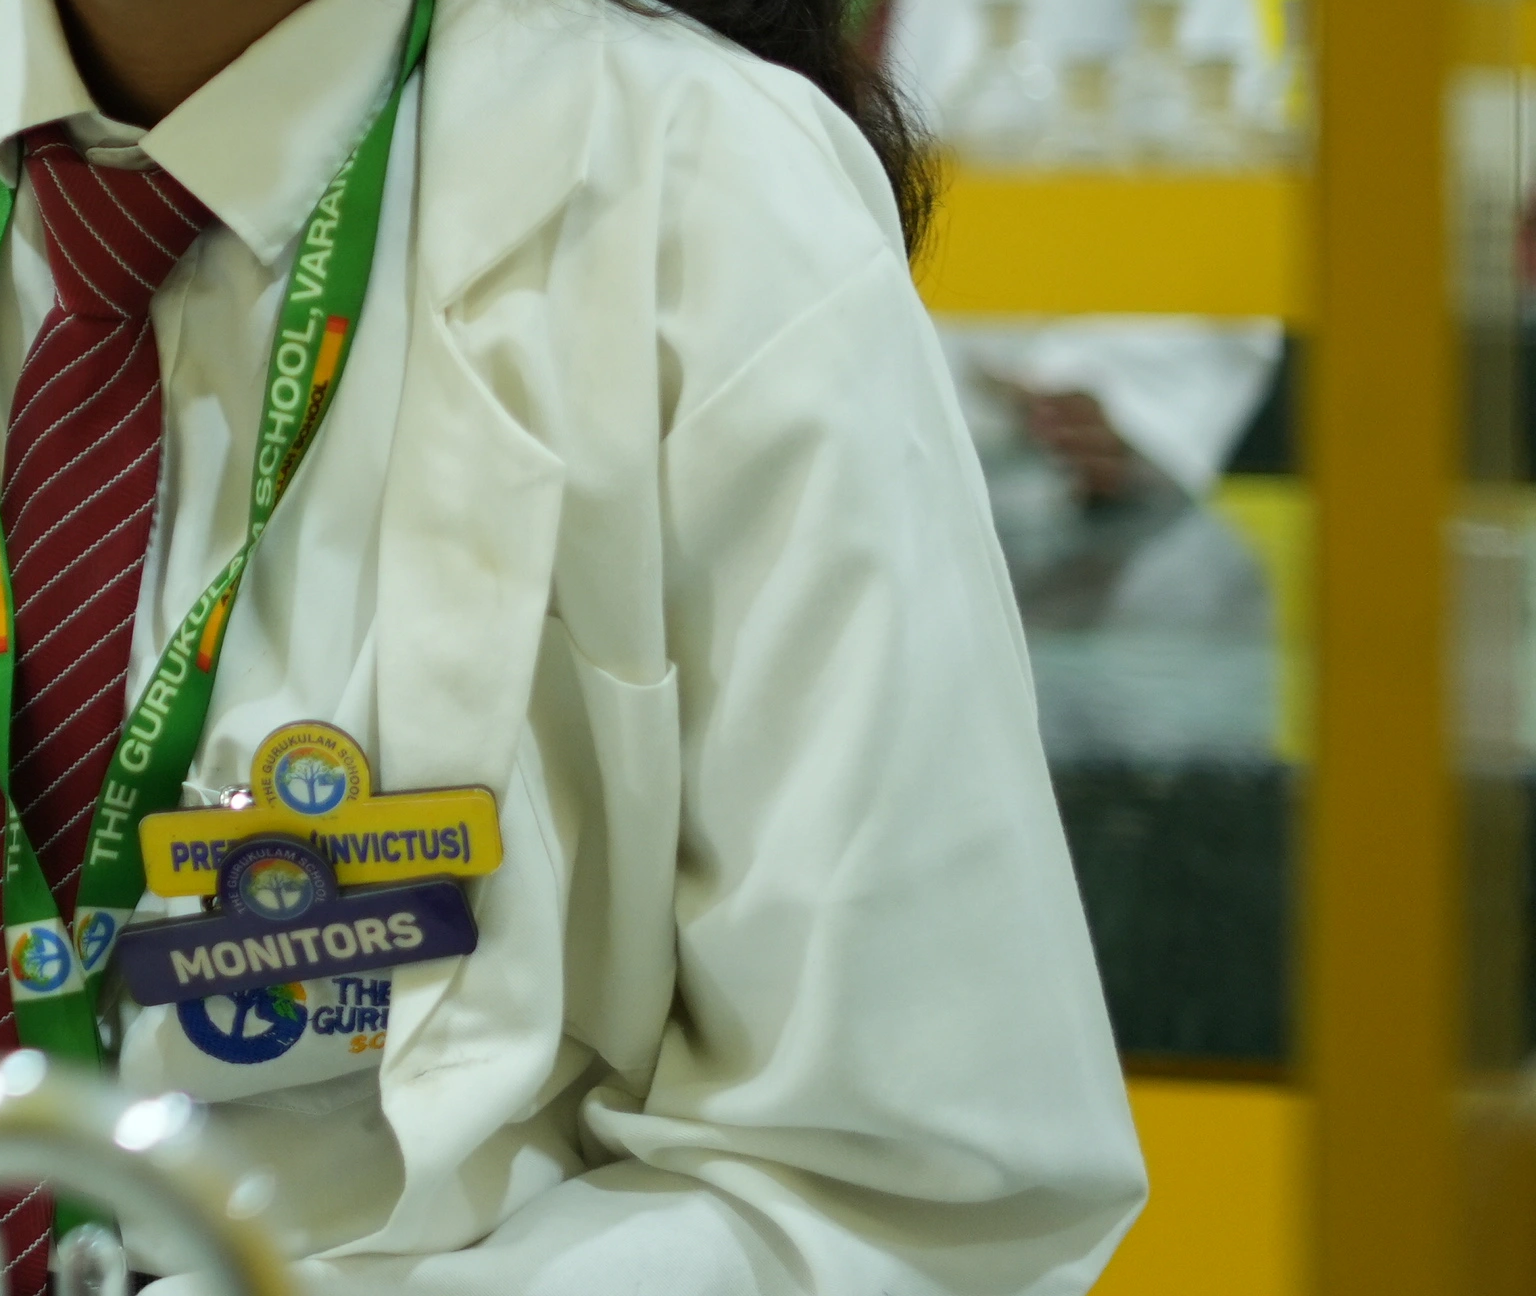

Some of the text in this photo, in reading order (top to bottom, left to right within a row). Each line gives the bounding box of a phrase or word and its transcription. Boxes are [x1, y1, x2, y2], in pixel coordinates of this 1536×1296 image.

[261, 733, 337, 774] GURUKULAM
[89, 779, 138, 866] THE
[226, 847, 297, 888] GURUKULAM
[169, 912, 424, 984] MONITORS
